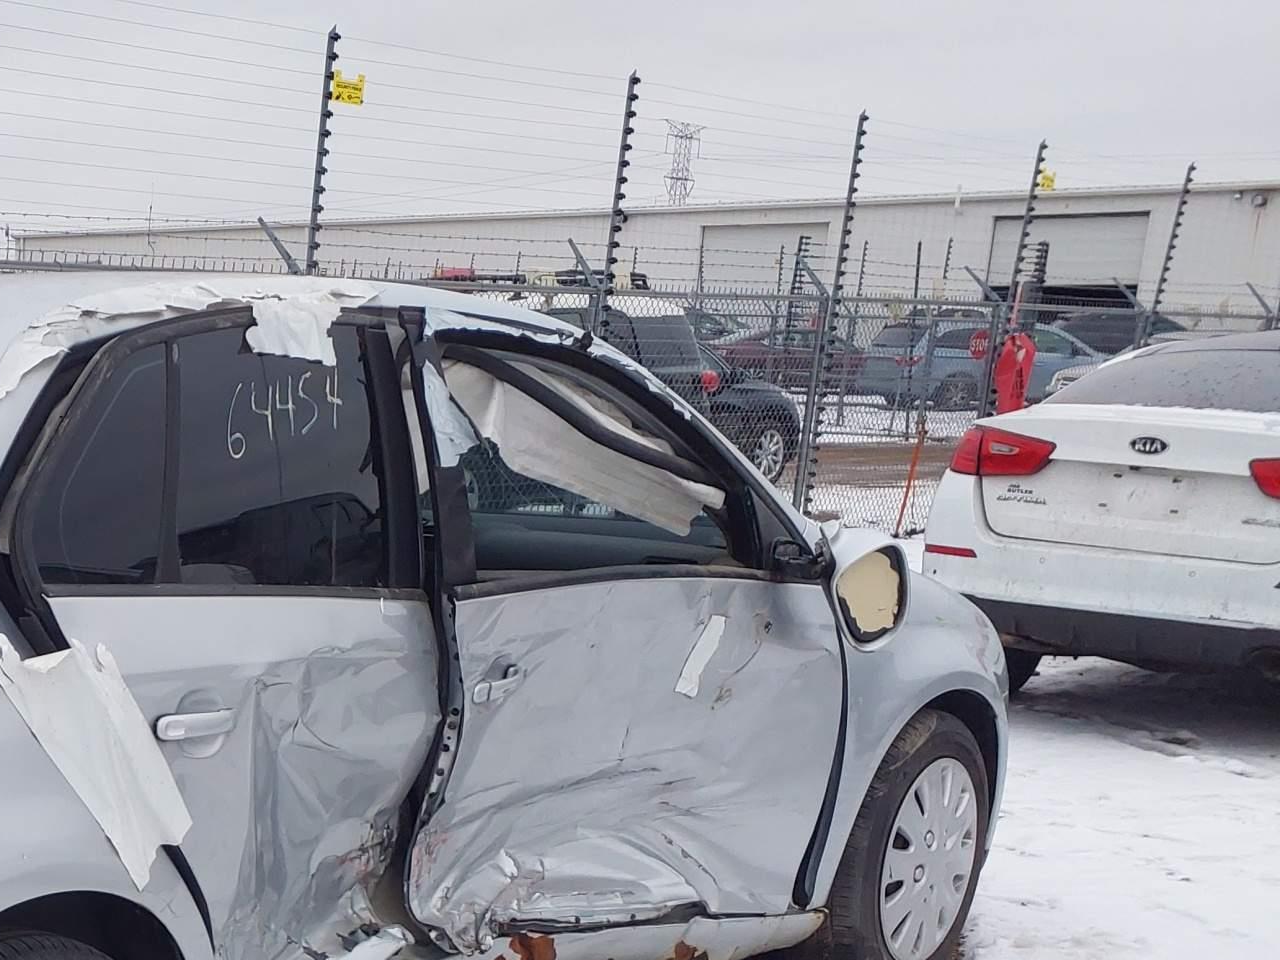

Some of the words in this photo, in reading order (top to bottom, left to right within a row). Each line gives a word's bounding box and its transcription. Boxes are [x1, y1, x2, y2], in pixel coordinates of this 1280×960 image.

[970, 338, 989, 352] STOP
[226, 367, 343, 459] 64454
[1134, 438, 1163, 453] KIA
